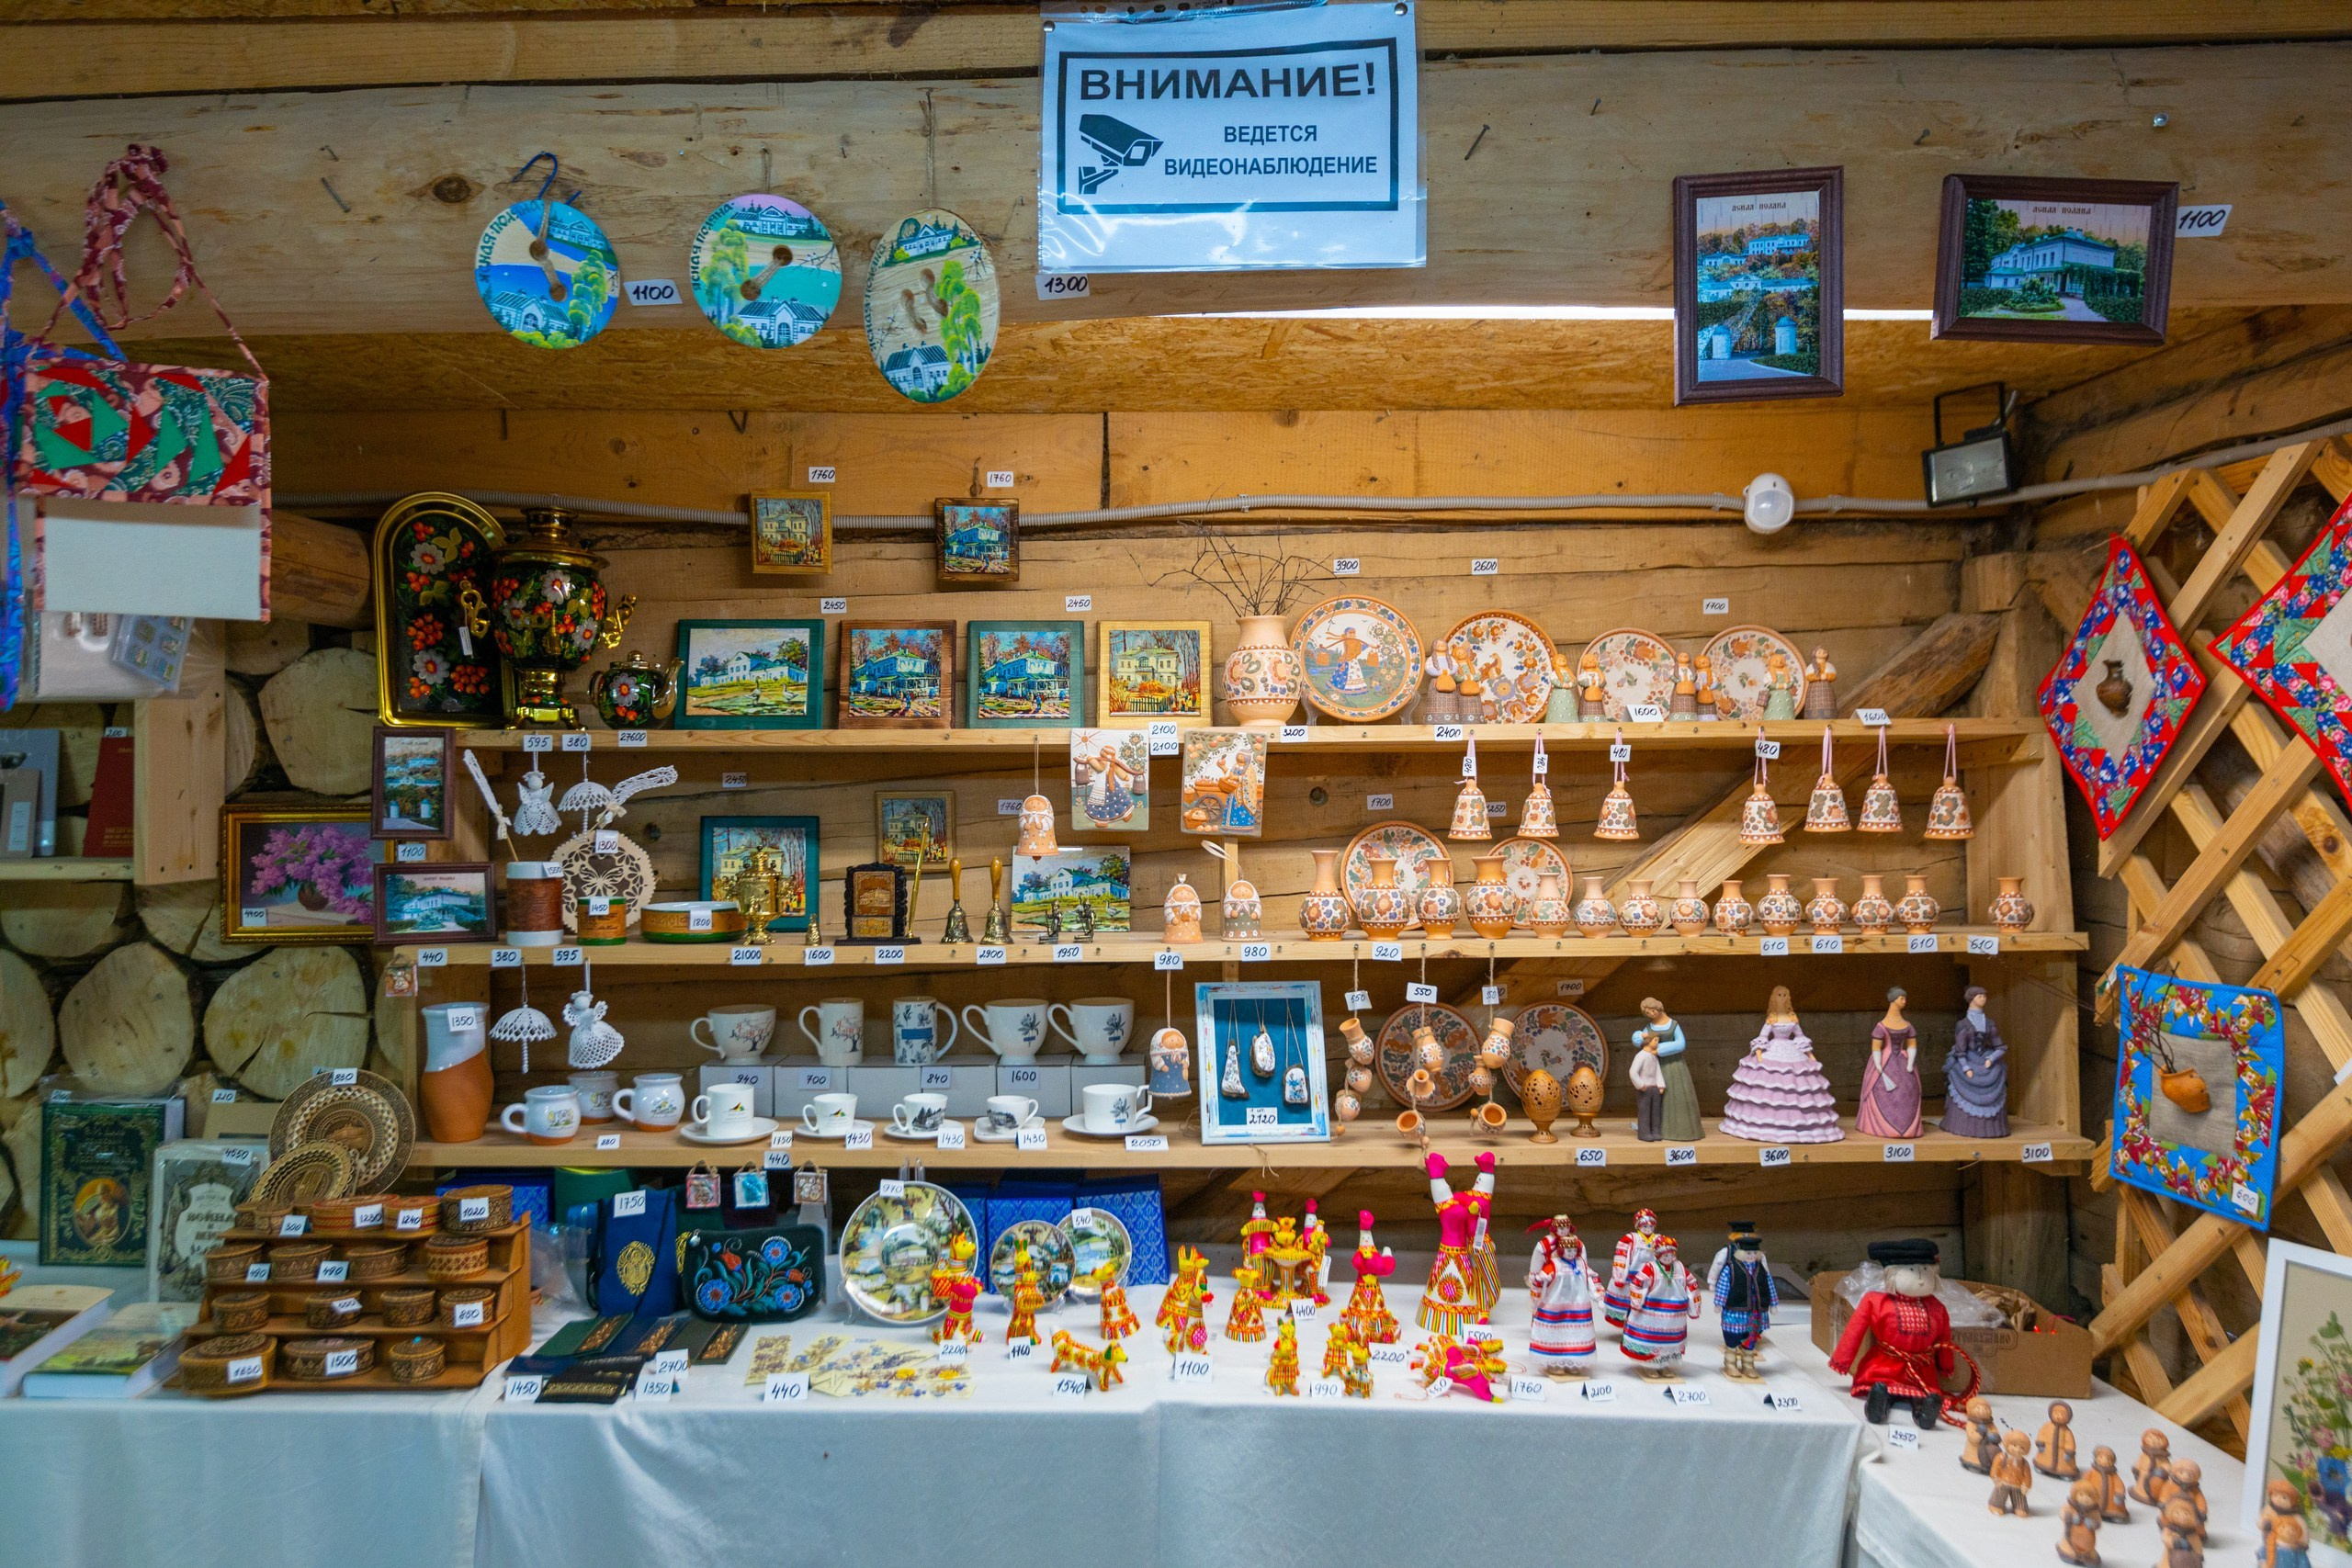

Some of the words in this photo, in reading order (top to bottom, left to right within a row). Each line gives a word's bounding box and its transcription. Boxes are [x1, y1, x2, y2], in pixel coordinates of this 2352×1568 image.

[1080, 62, 1375, 101] ВНИМАНИЕ!
[1225, 125, 1317, 147] ВЕДЕТСЯ
[1165, 156, 1377, 179] ВИДЕОНАБЛЮДЕНИЕ
[2178, 209, 2224, 229] 1100
[1045, 276, 1088, 294] 1300
[632, 283, 674, 300] 1100
[810, 468, 835, 480] 1760
[989, 473, 1012, 484] 1760
[1336, 560, 1359, 570] 3900
[1474, 560, 1498, 572] 2600
[823, 601, 845, 611] 2450
[1068, 598, 1091, 608] 2450
[1704, 602, 1725, 611] 1700
[1634, 706, 1657, 717] 1600
[1863, 712, 1887, 723] 1600
[1151, 725, 1176, 736] 2100
[1436, 727, 1461, 739] 2400
[527, 736, 550, 748] 595
[566, 736, 588, 748] 380
[619, 732, 646, 742] 27600
[1152, 741, 1177, 752] 2100
[1613, 746, 1629, 759] 480
[1757, 743, 1778, 756] 480
[1464, 757, 1473, 775] 480
[1536, 756, 1545, 773] 480
[724, 774, 746, 784] 2450
[1000, 803, 1023, 812] 1760
[1370, 796, 1392, 807] 1700
[401, 845, 424, 857] 1100
[591, 902, 608, 913] 1450
[1763, 940, 1784, 952] 610
[1815, 939, 1838, 950] 610
[1910, 937, 1935, 949] 610
[1970, 939, 1994, 950] 610
[423, 950, 443, 962] 440
[496, 950, 517, 962] 380
[556, 949, 578, 962] 595
[734, 950, 762, 961] 21000
[808, 950, 831, 961] 1600
[878, 949, 903, 960] 2200
[978, 949, 1003, 960] 2900
[1057, 946, 1079, 958] 1950
[1244, 946, 1267, 958] 980
[1375, 946, 1398, 958] 920
[1159, 953, 1180, 965] 980
[1414, 987, 1432, 997] 550
[1560, 982, 1582, 992] 1700
[1351, 993, 1366, 1004] 550
[451, 1015, 474, 1027] 1350
[737, 1074, 759, 1085] 940
[806, 1075, 826, 1085] 700
[926, 1073, 948, 1084] 840
[1012, 1071, 1036, 1082] 1600
[1249, 1113, 1276, 1124] 2120
[847, 1133, 871, 1145] 1430
[942, 1133, 964, 1145] 1430
[1023, 1133, 1046, 1144] 1430
[1131, 1138, 1161, 1148] 2050
[1580, 1150, 1603, 1162] 650
[1669, 1149, 1695, 1161] 3600
[1764, 1150, 1789, 1161] 3600
[1885, 1146, 1911, 1158] 3100
[2023, 1147, 2050, 1159] 3100
[769, 1154, 790, 1166] 440
[620, 1194, 646, 1209] 1750
[2236, 1189, 2256, 1206] 600
[1296, 1304, 1317, 1316] 4400
[942, 1344, 966, 1356] 2200
[1372, 1349, 1405, 1362] 2200
[332, 1353, 357, 1366] 1500
[660, 1359, 689, 1373] 2700
[1180, 1360, 1209, 1375] 1100
[511, 1381, 538, 1395] 1450
[644, 1381, 670, 1394] 1350
[772, 1382, 800, 1399] 440
[1057, 1379, 1084, 1393] 1540
[1315, 1383, 1337, 1395] 990
[1514, 1381, 1542, 1393] 1760
[1590, 1385, 1612, 1396] 2100
[1678, 1390, 1706, 1402] 2700
